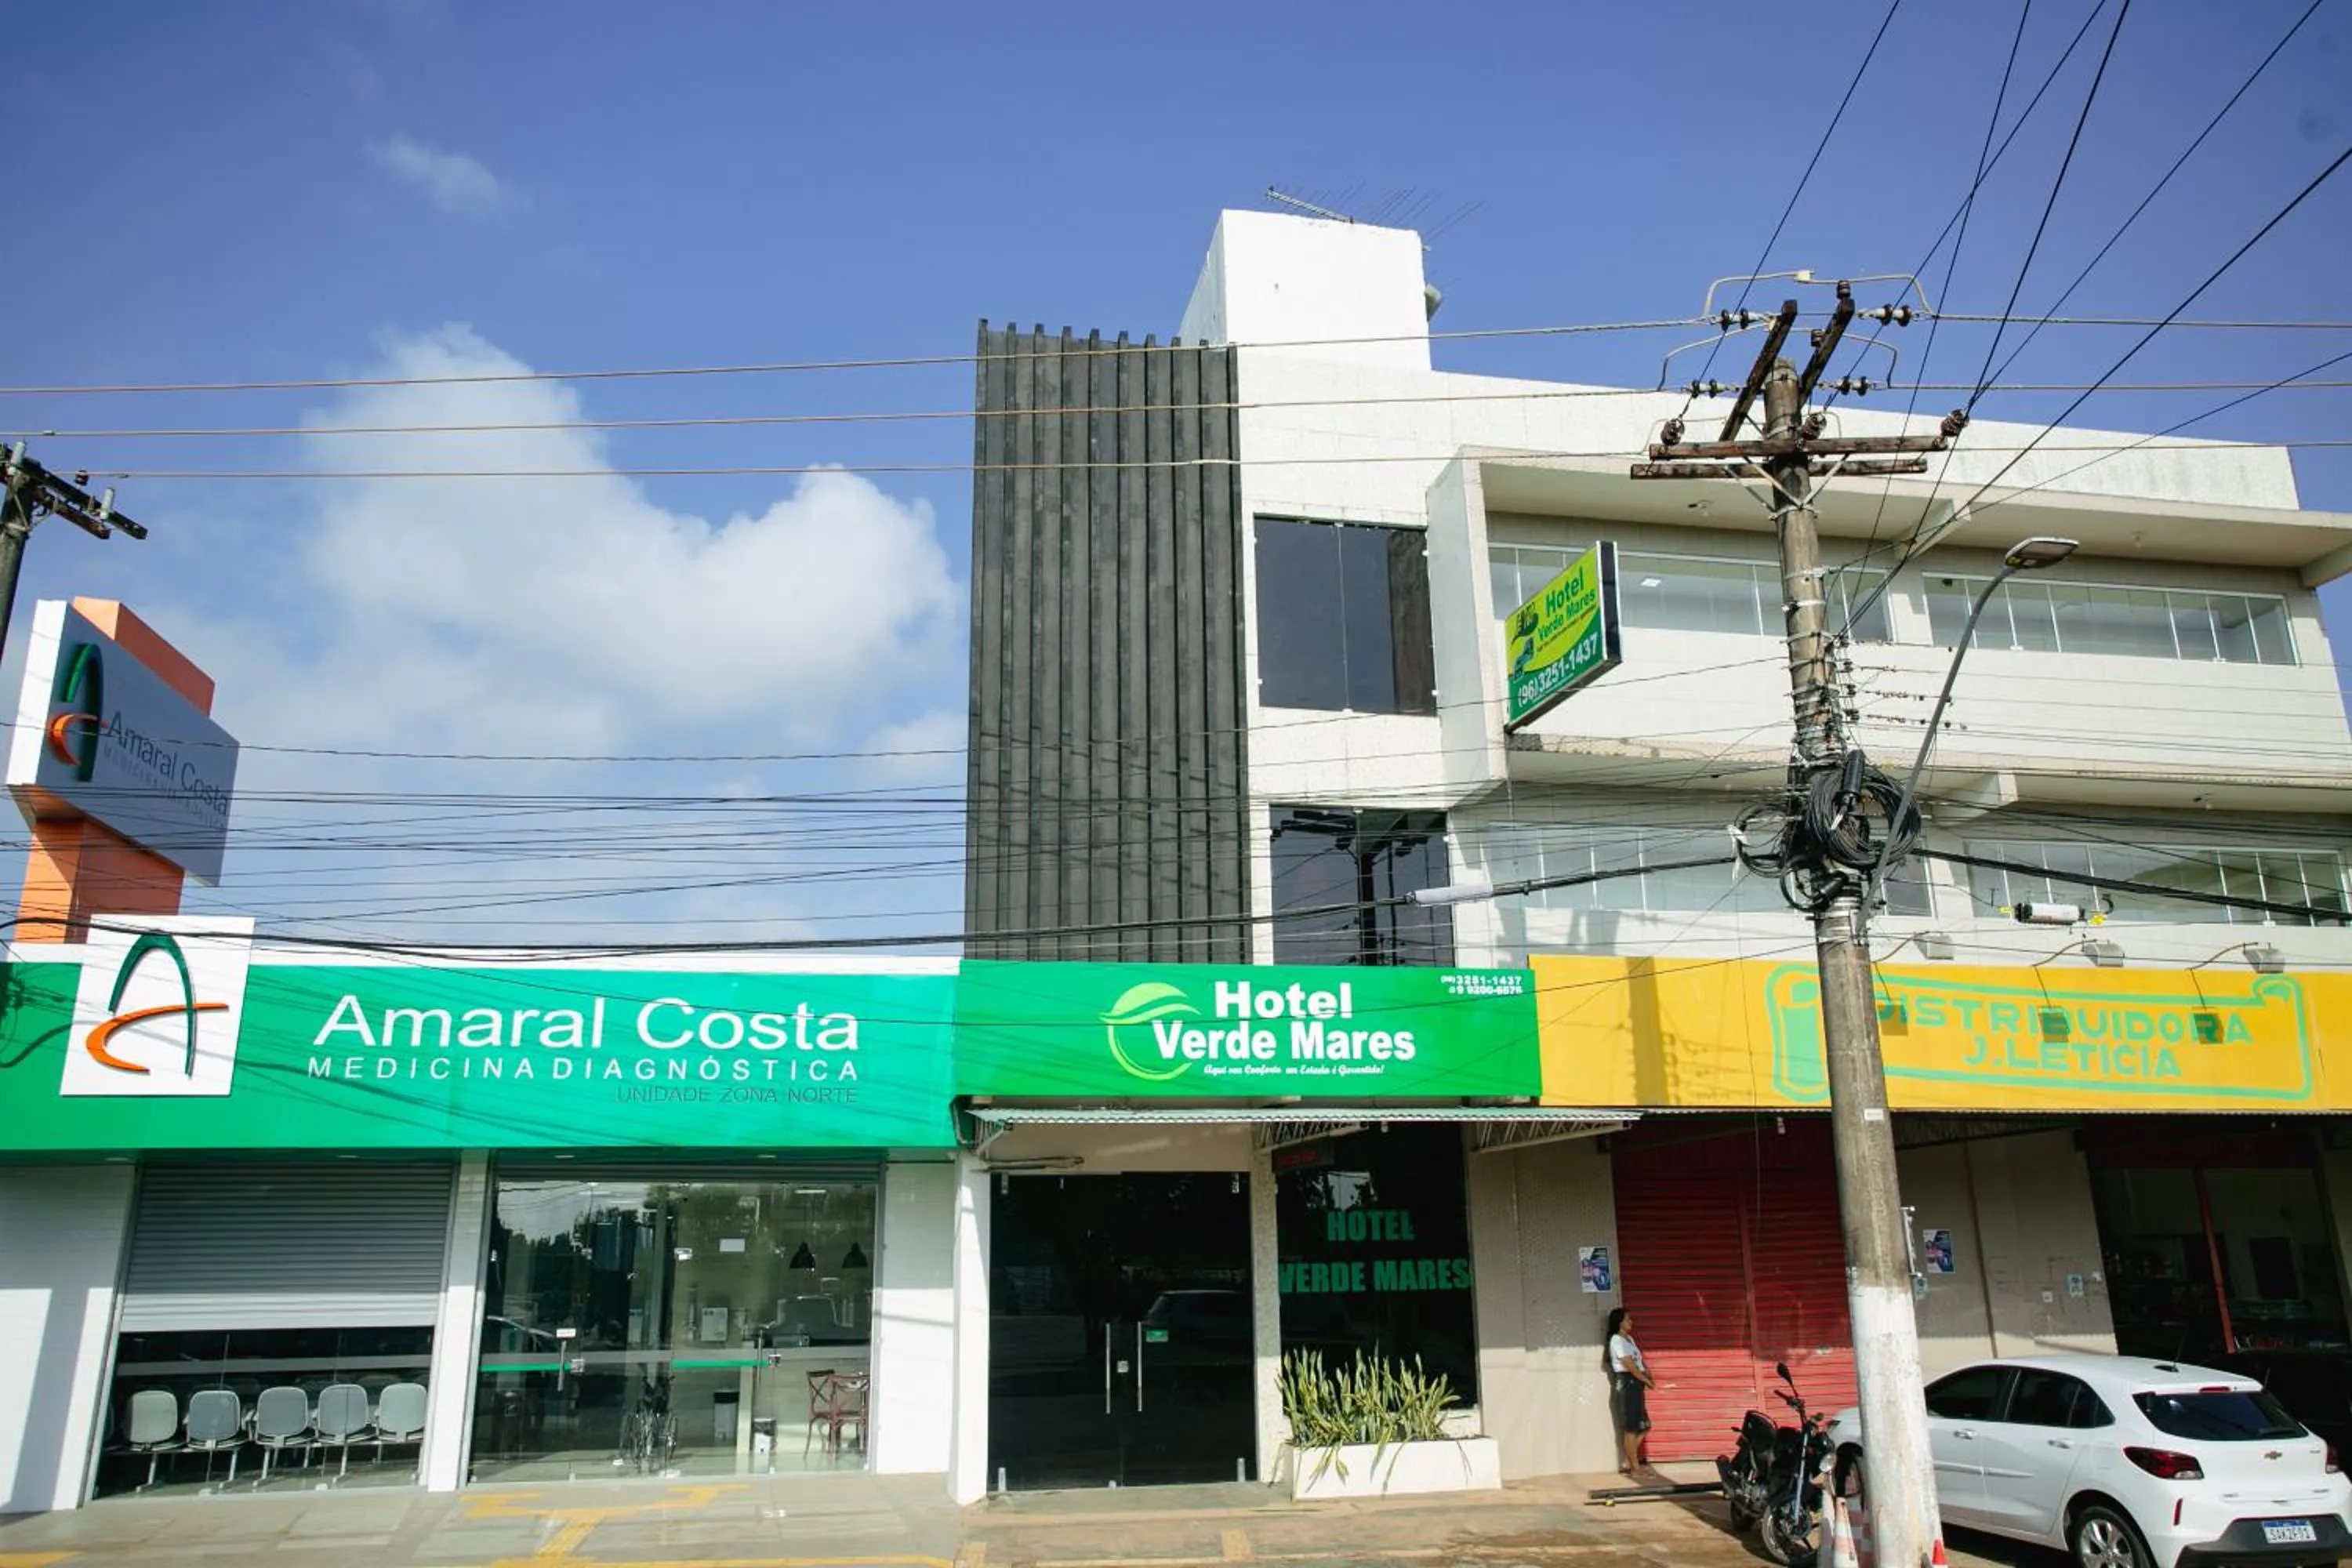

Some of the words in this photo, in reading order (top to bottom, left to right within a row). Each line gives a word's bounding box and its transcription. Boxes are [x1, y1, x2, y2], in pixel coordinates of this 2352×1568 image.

[1545, 566, 1584, 619] Hotel
[1537, 612, 1564, 642] Verde
[1567, 588, 1596, 623] Mares
[1517, 630, 1599, 708] (96)3251-1437
[107, 711, 178, 782] Amaral
[180, 761, 228, 817] Costa
[1215, 981, 1352, 1019] Hotel
[313, 994, 605, 1048] Amaral
[637, 996, 859, 1051] Costa
[1152, 1020, 1277, 1059] Verde
[1290, 1021, 1416, 1061] Mares
[307, 1056, 535, 1080] MEDICINA
[552, 1055, 858, 1081] DIAGNÓSTICA
[616, 1085, 713, 1103] UNIDADE
[717, 1086, 779, 1103] ZONA
[787, 1087, 858, 1104] NORTE
[1327, 1210, 1415, 1242] HOTEL
[1278, 1261, 1367, 1294] VERDE
[1374, 1258, 1475, 1291] MARES
